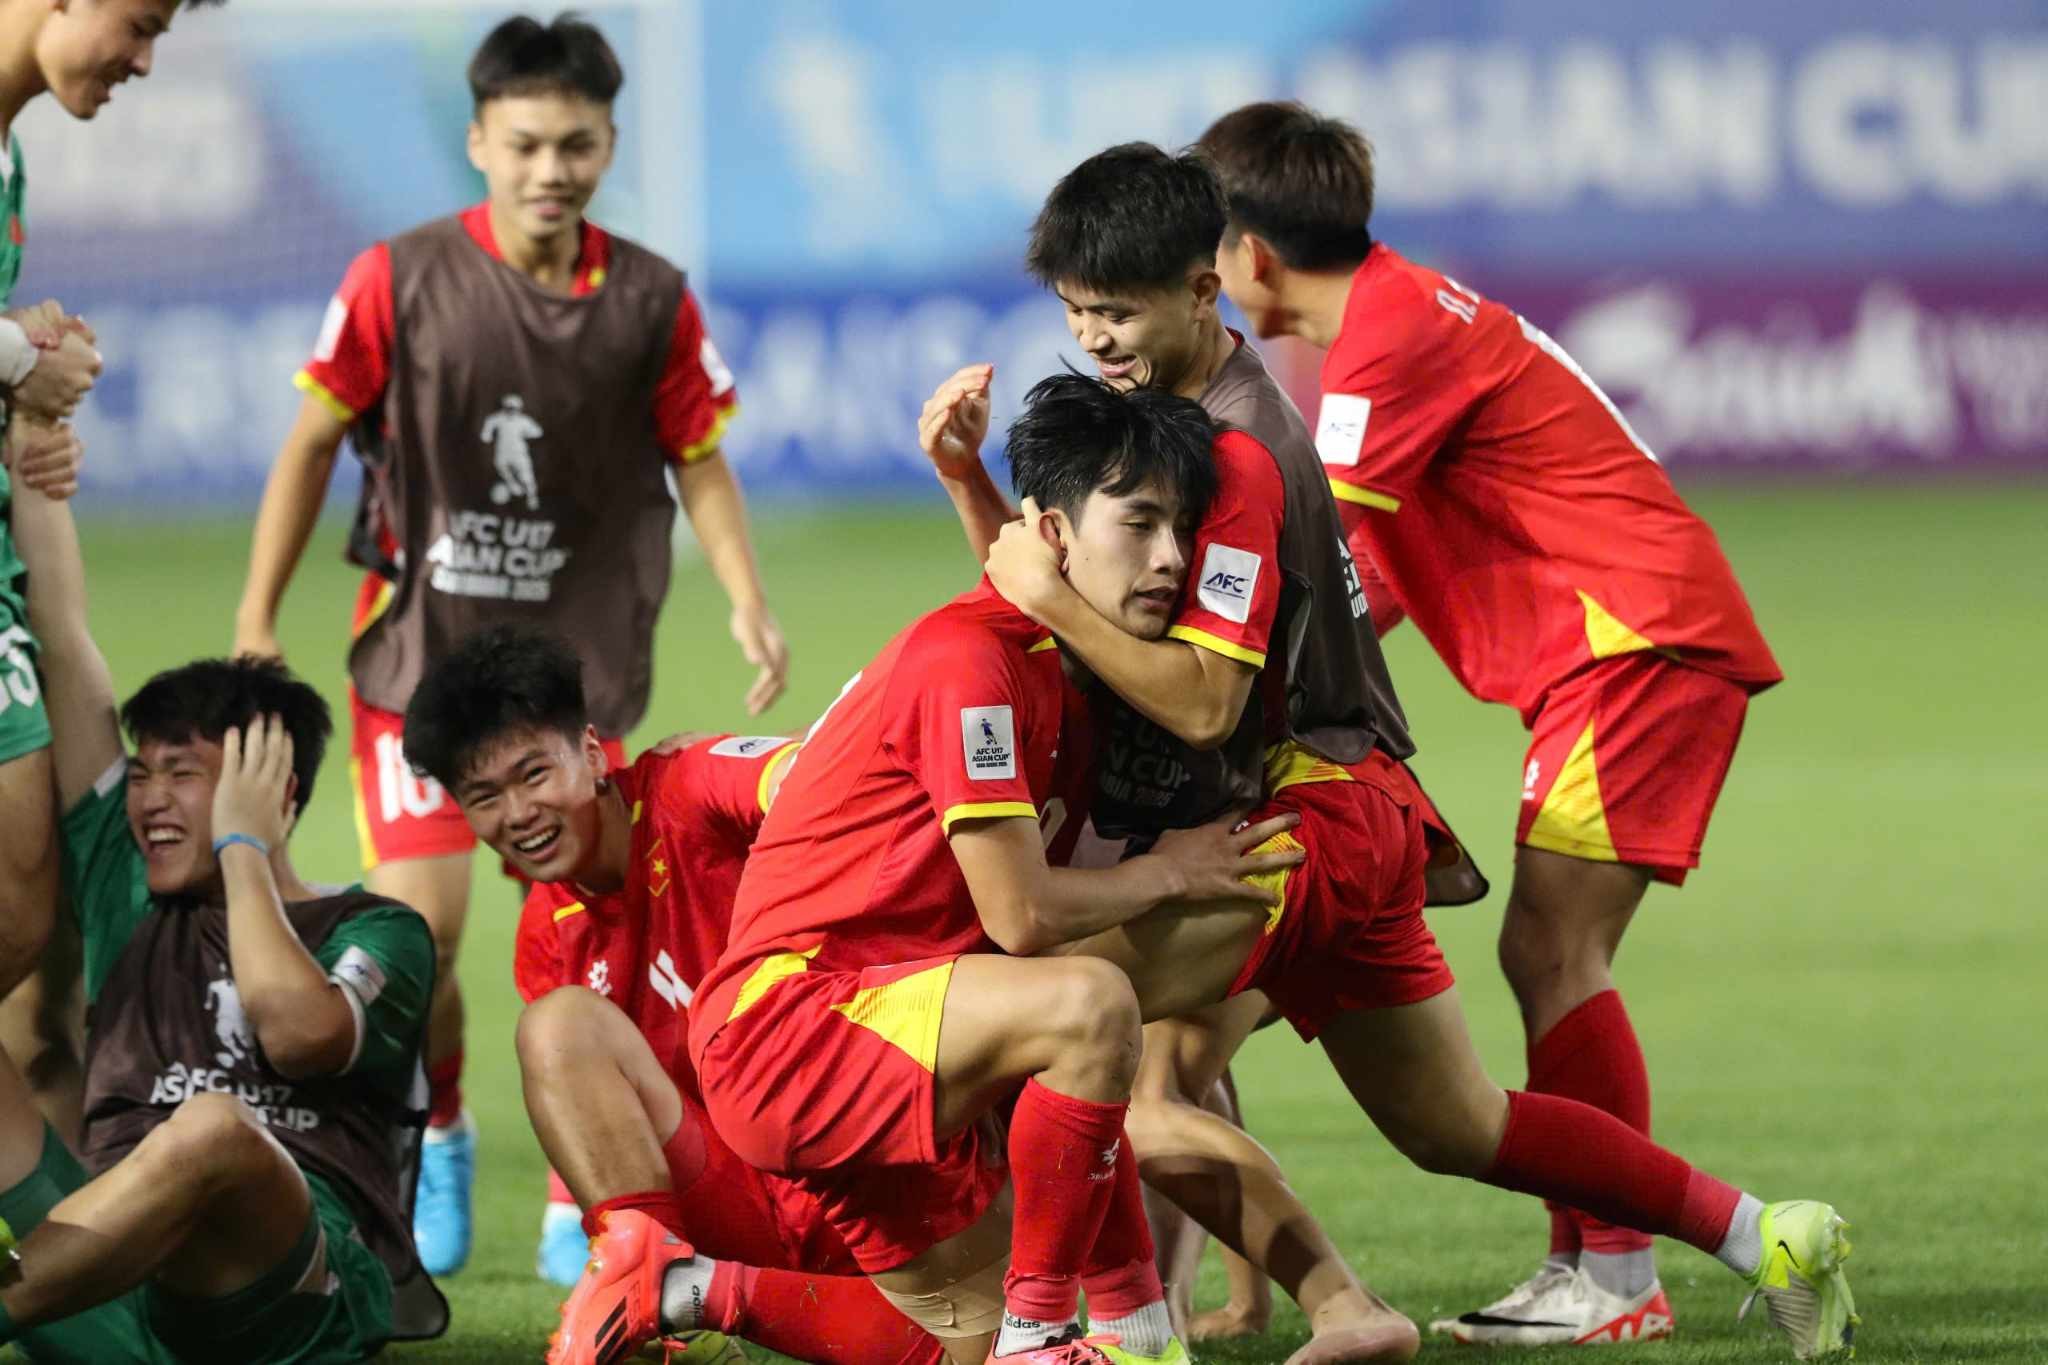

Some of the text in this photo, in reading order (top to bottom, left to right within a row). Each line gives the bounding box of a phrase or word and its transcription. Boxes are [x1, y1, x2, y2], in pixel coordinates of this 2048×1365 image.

[1205, 572, 1249, 593] AFC
[972, 752, 1009, 762] ASIAN CUP
[976, 748, 990, 756] AFC
